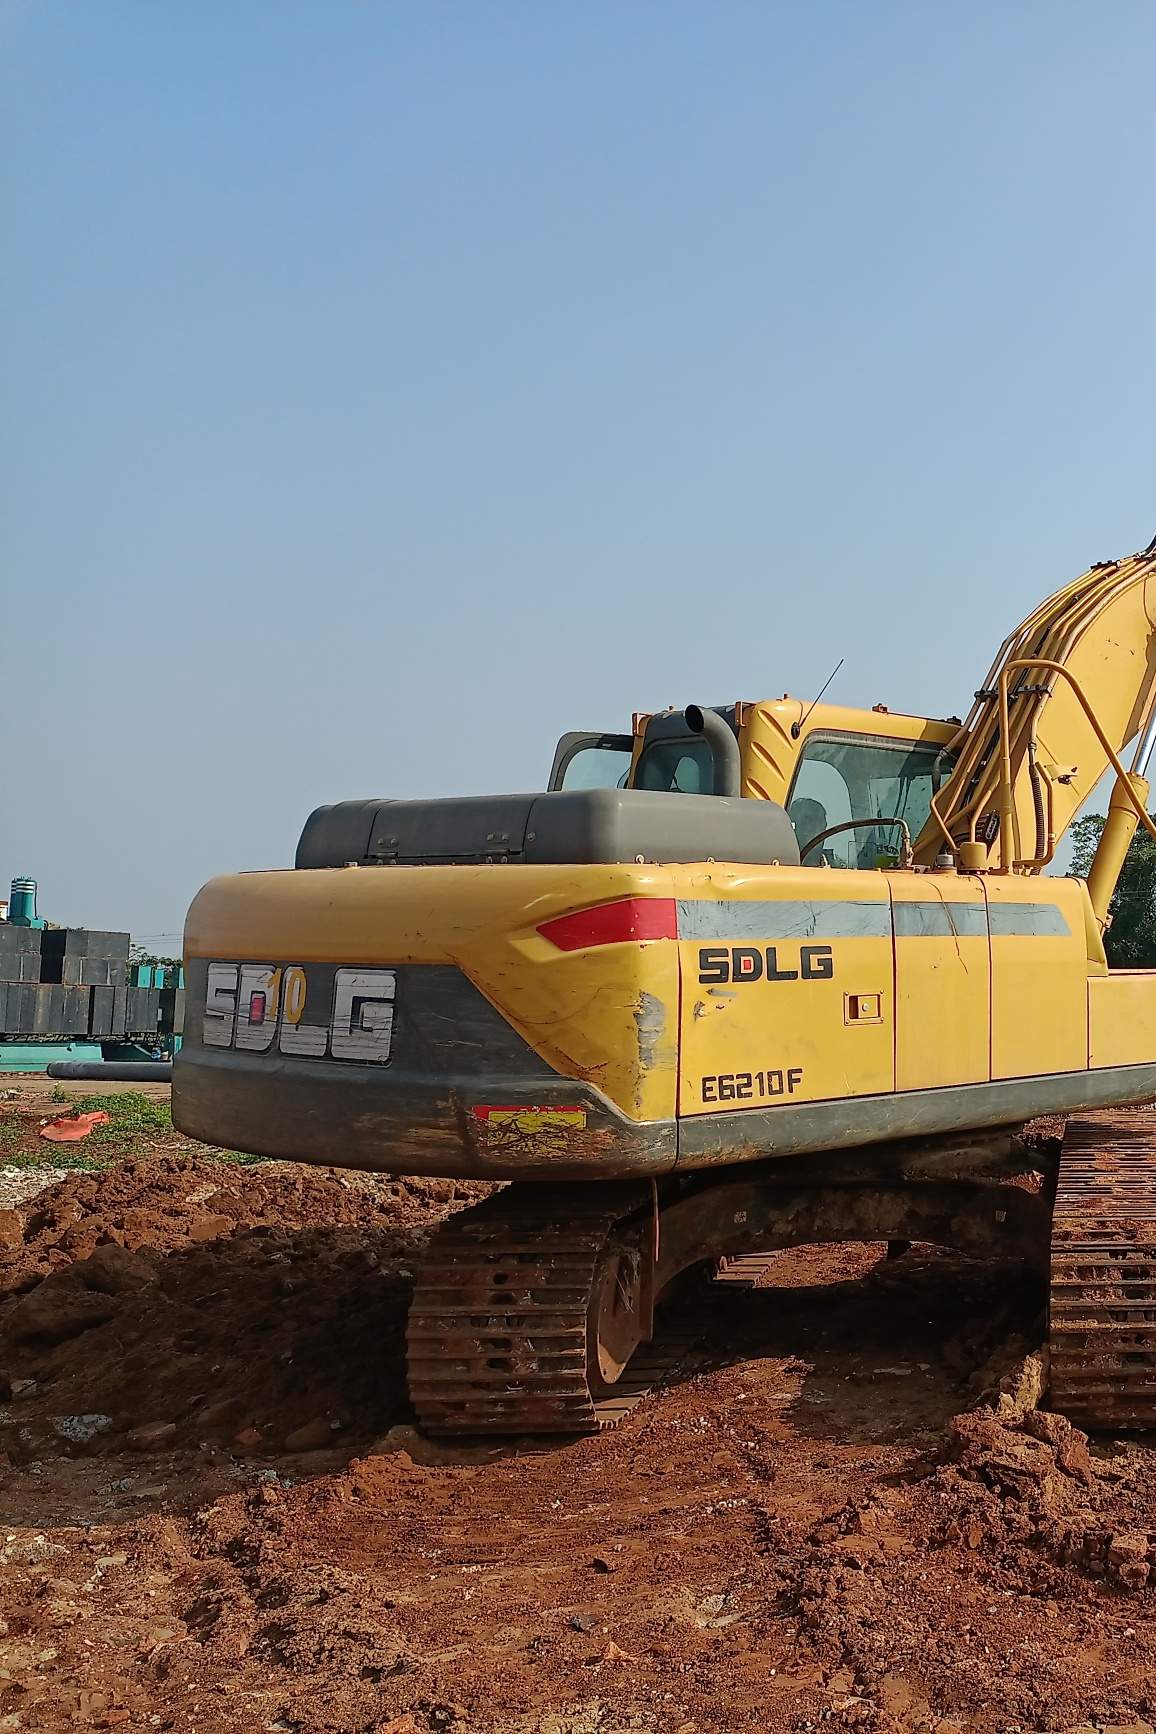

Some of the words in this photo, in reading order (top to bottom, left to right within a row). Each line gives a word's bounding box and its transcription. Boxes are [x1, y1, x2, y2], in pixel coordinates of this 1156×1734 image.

[698, 946, 834, 984] SDLG
[202, 962, 397, 1064] SDLG
[701, 1068, 803, 1103] E6210F
